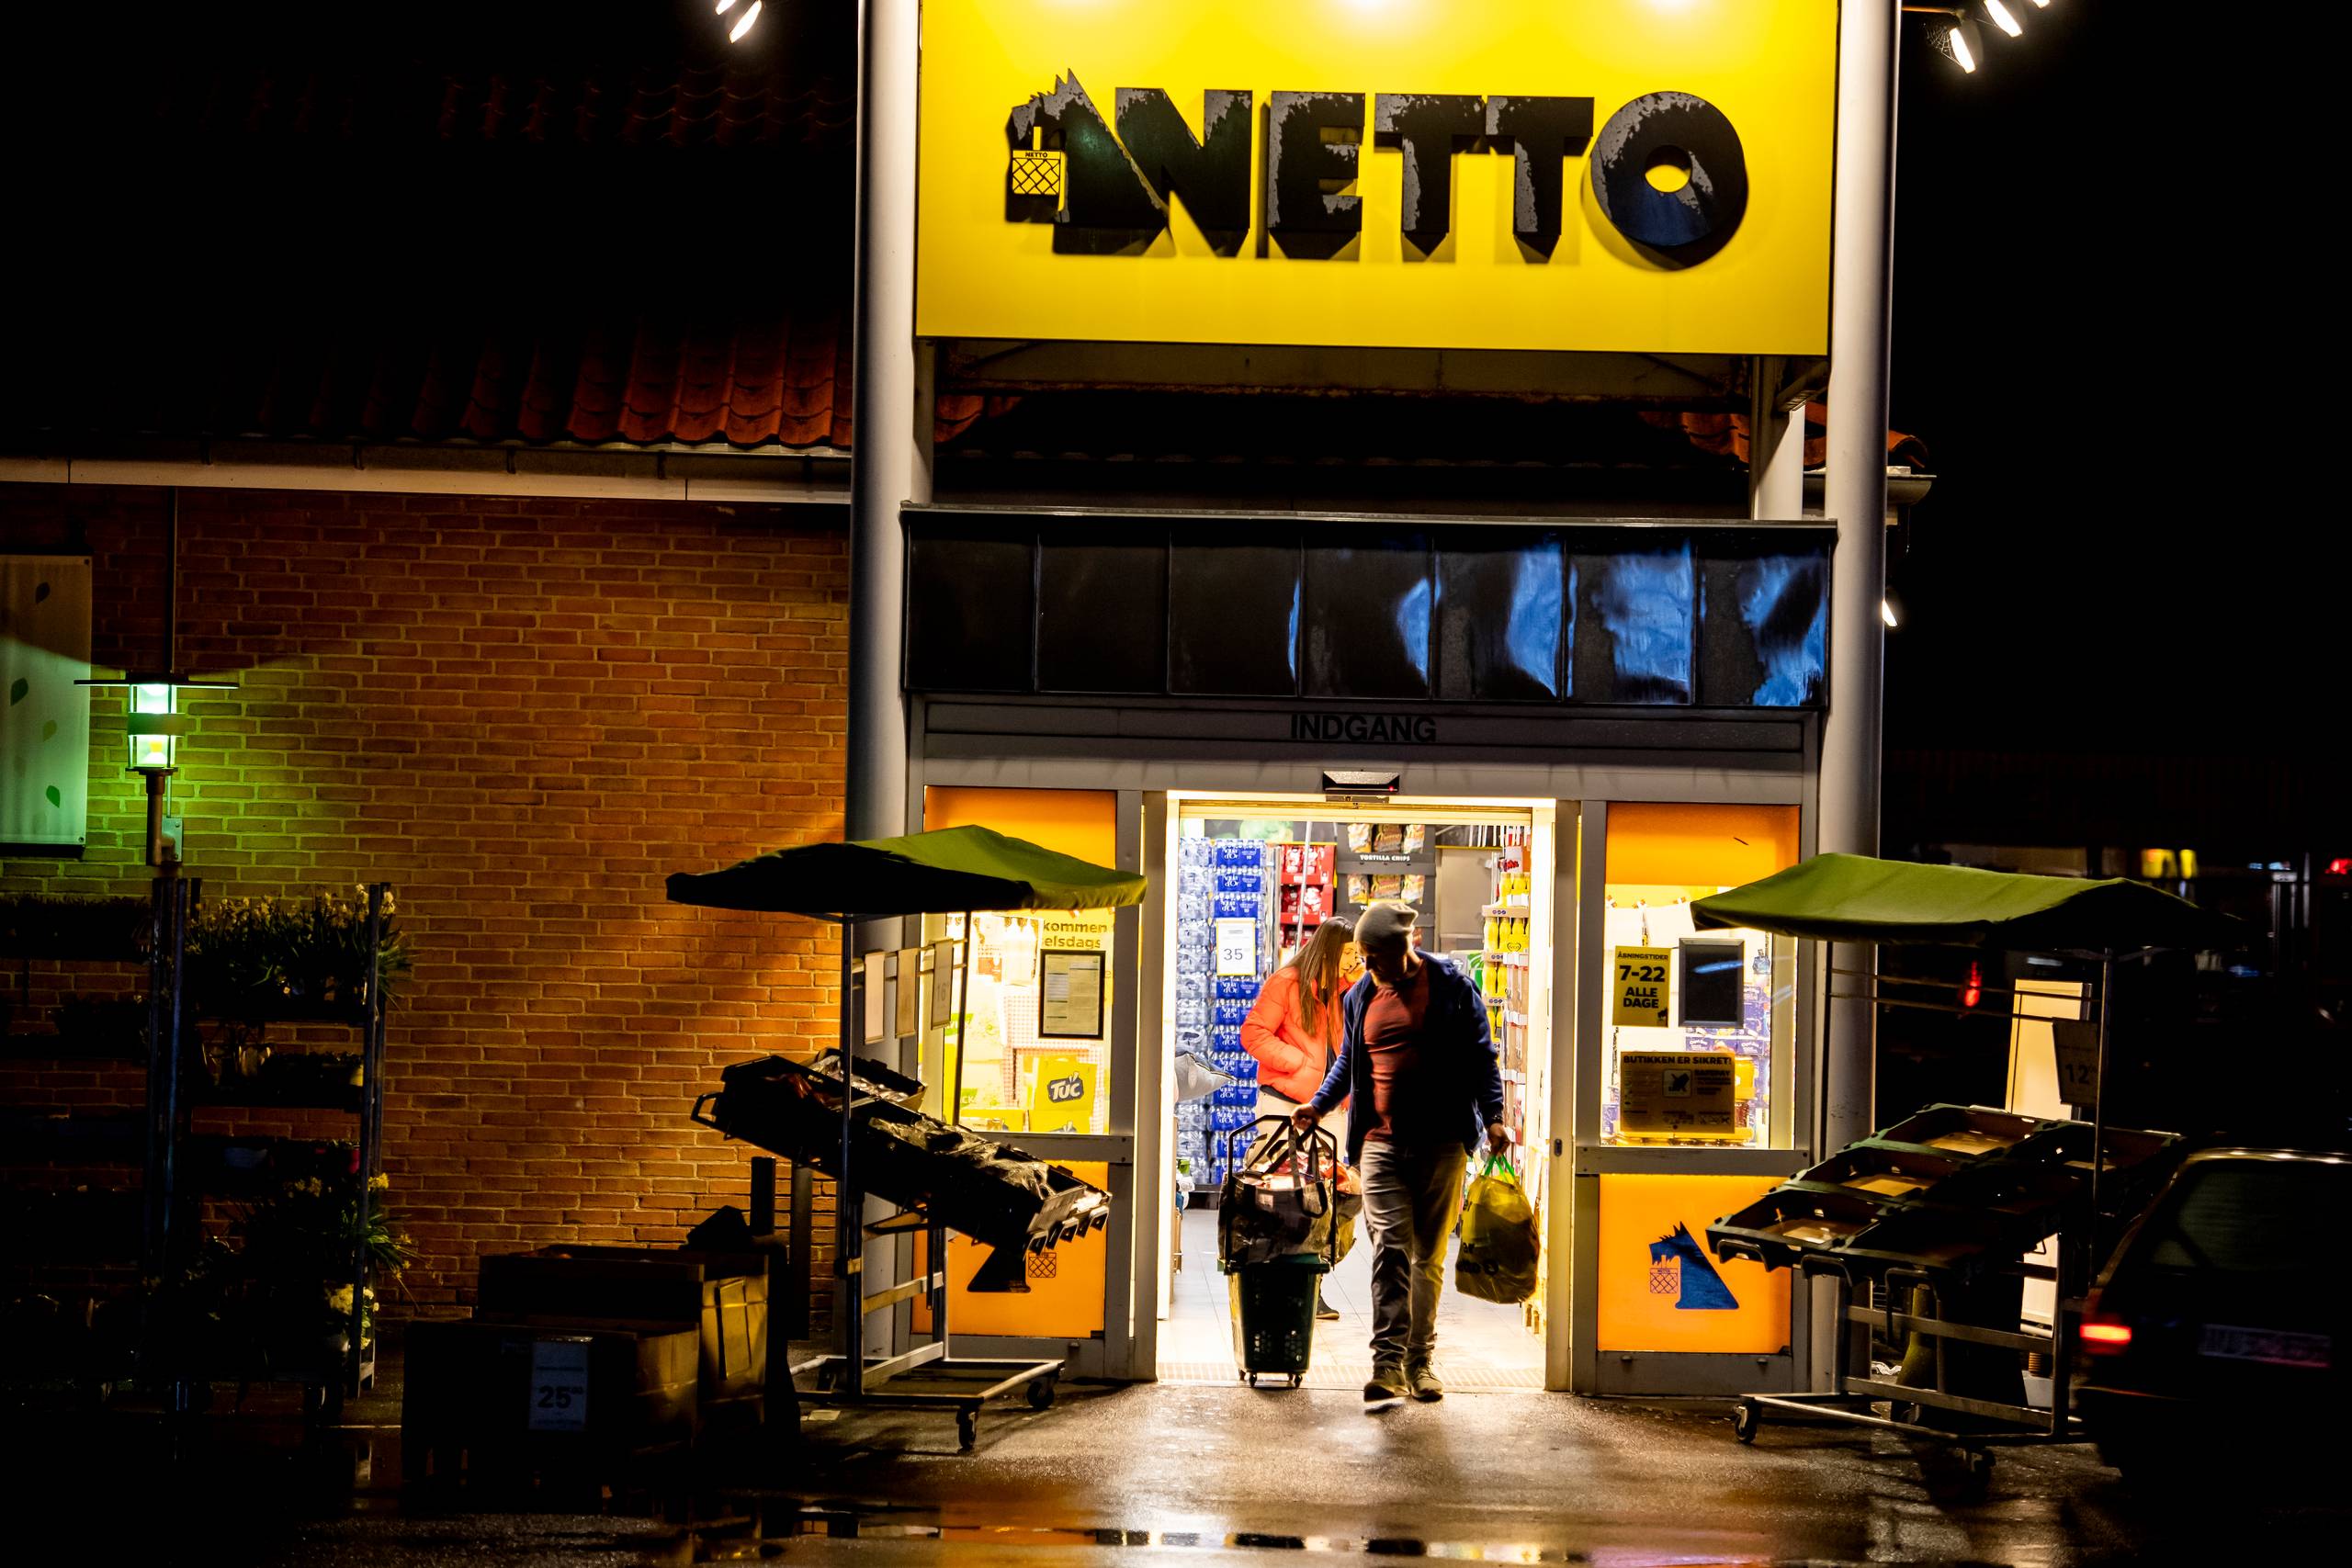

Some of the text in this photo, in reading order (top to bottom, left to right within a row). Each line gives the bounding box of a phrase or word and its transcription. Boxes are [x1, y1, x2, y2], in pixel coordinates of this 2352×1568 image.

[1114, 89, 1748, 270] NETTO
[1290, 714, 1437, 743] INDGANG
[1224, 948, 1243, 961] 35
[1617, 951, 1668, 961] ÅBNINGSTIDER
[1620, 965, 1665, 982] 7-22
[1625, 987, 1657, 998] ALLE
[1623, 998, 1659, 1009] DAGE
[1623, 1055, 1675, 1064] BUTIKKEN
[1692, 1056, 1732, 1065] SIKRET!
[2065, 1064, 2090, 1085] 12
[538, 1385, 571, 1408] 25
